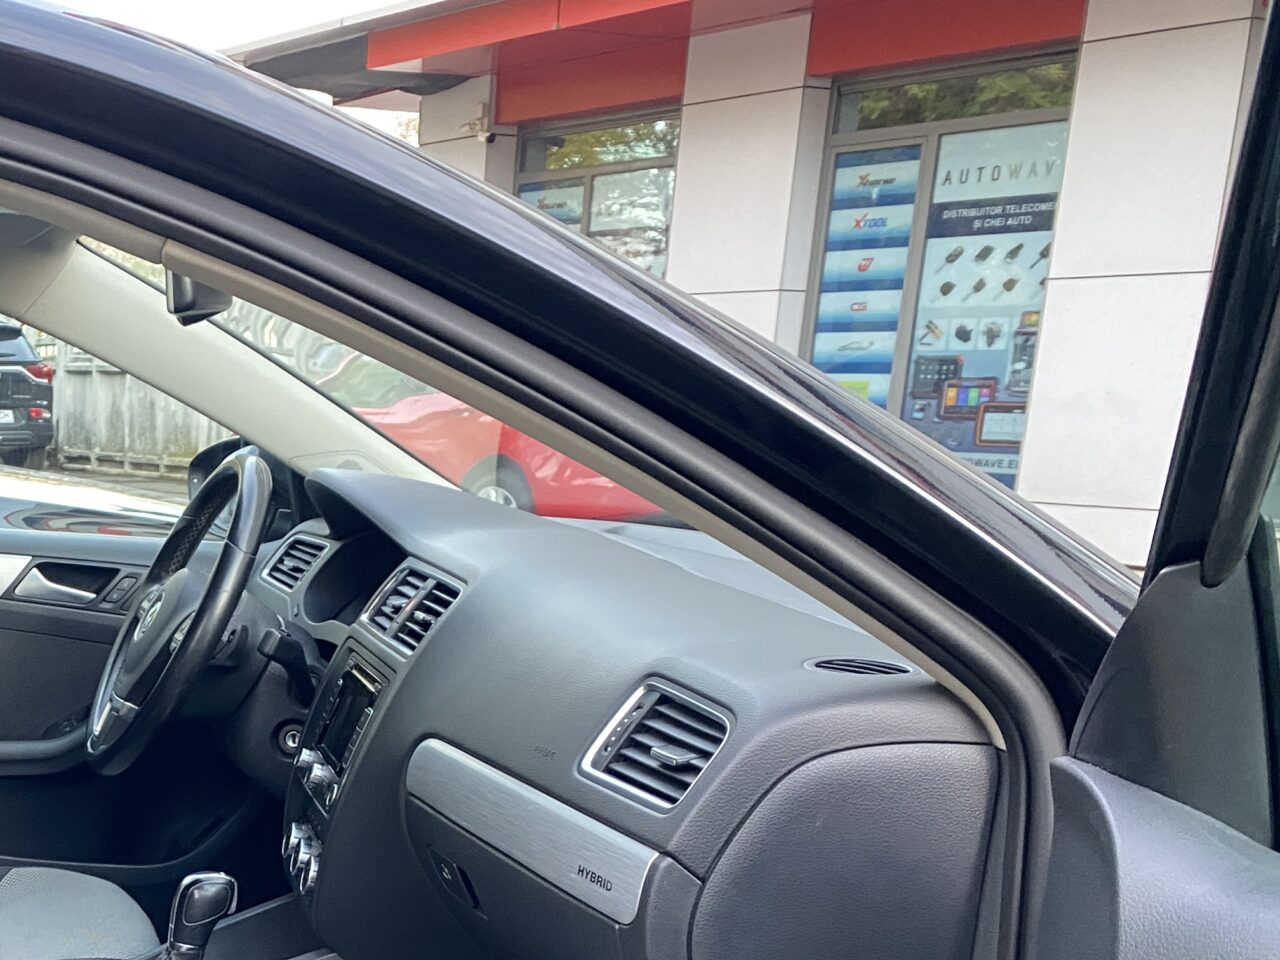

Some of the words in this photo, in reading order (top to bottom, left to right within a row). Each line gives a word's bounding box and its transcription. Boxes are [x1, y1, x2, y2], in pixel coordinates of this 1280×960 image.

[942, 206, 1003, 219] DISTRIBUITOR
[1006, 201, 1056, 214] TELECOME
[983, 217, 1005, 228] CHEI
[1006, 215, 1033, 226] AUTO
[577, 865, 613, 892] HYBRID
